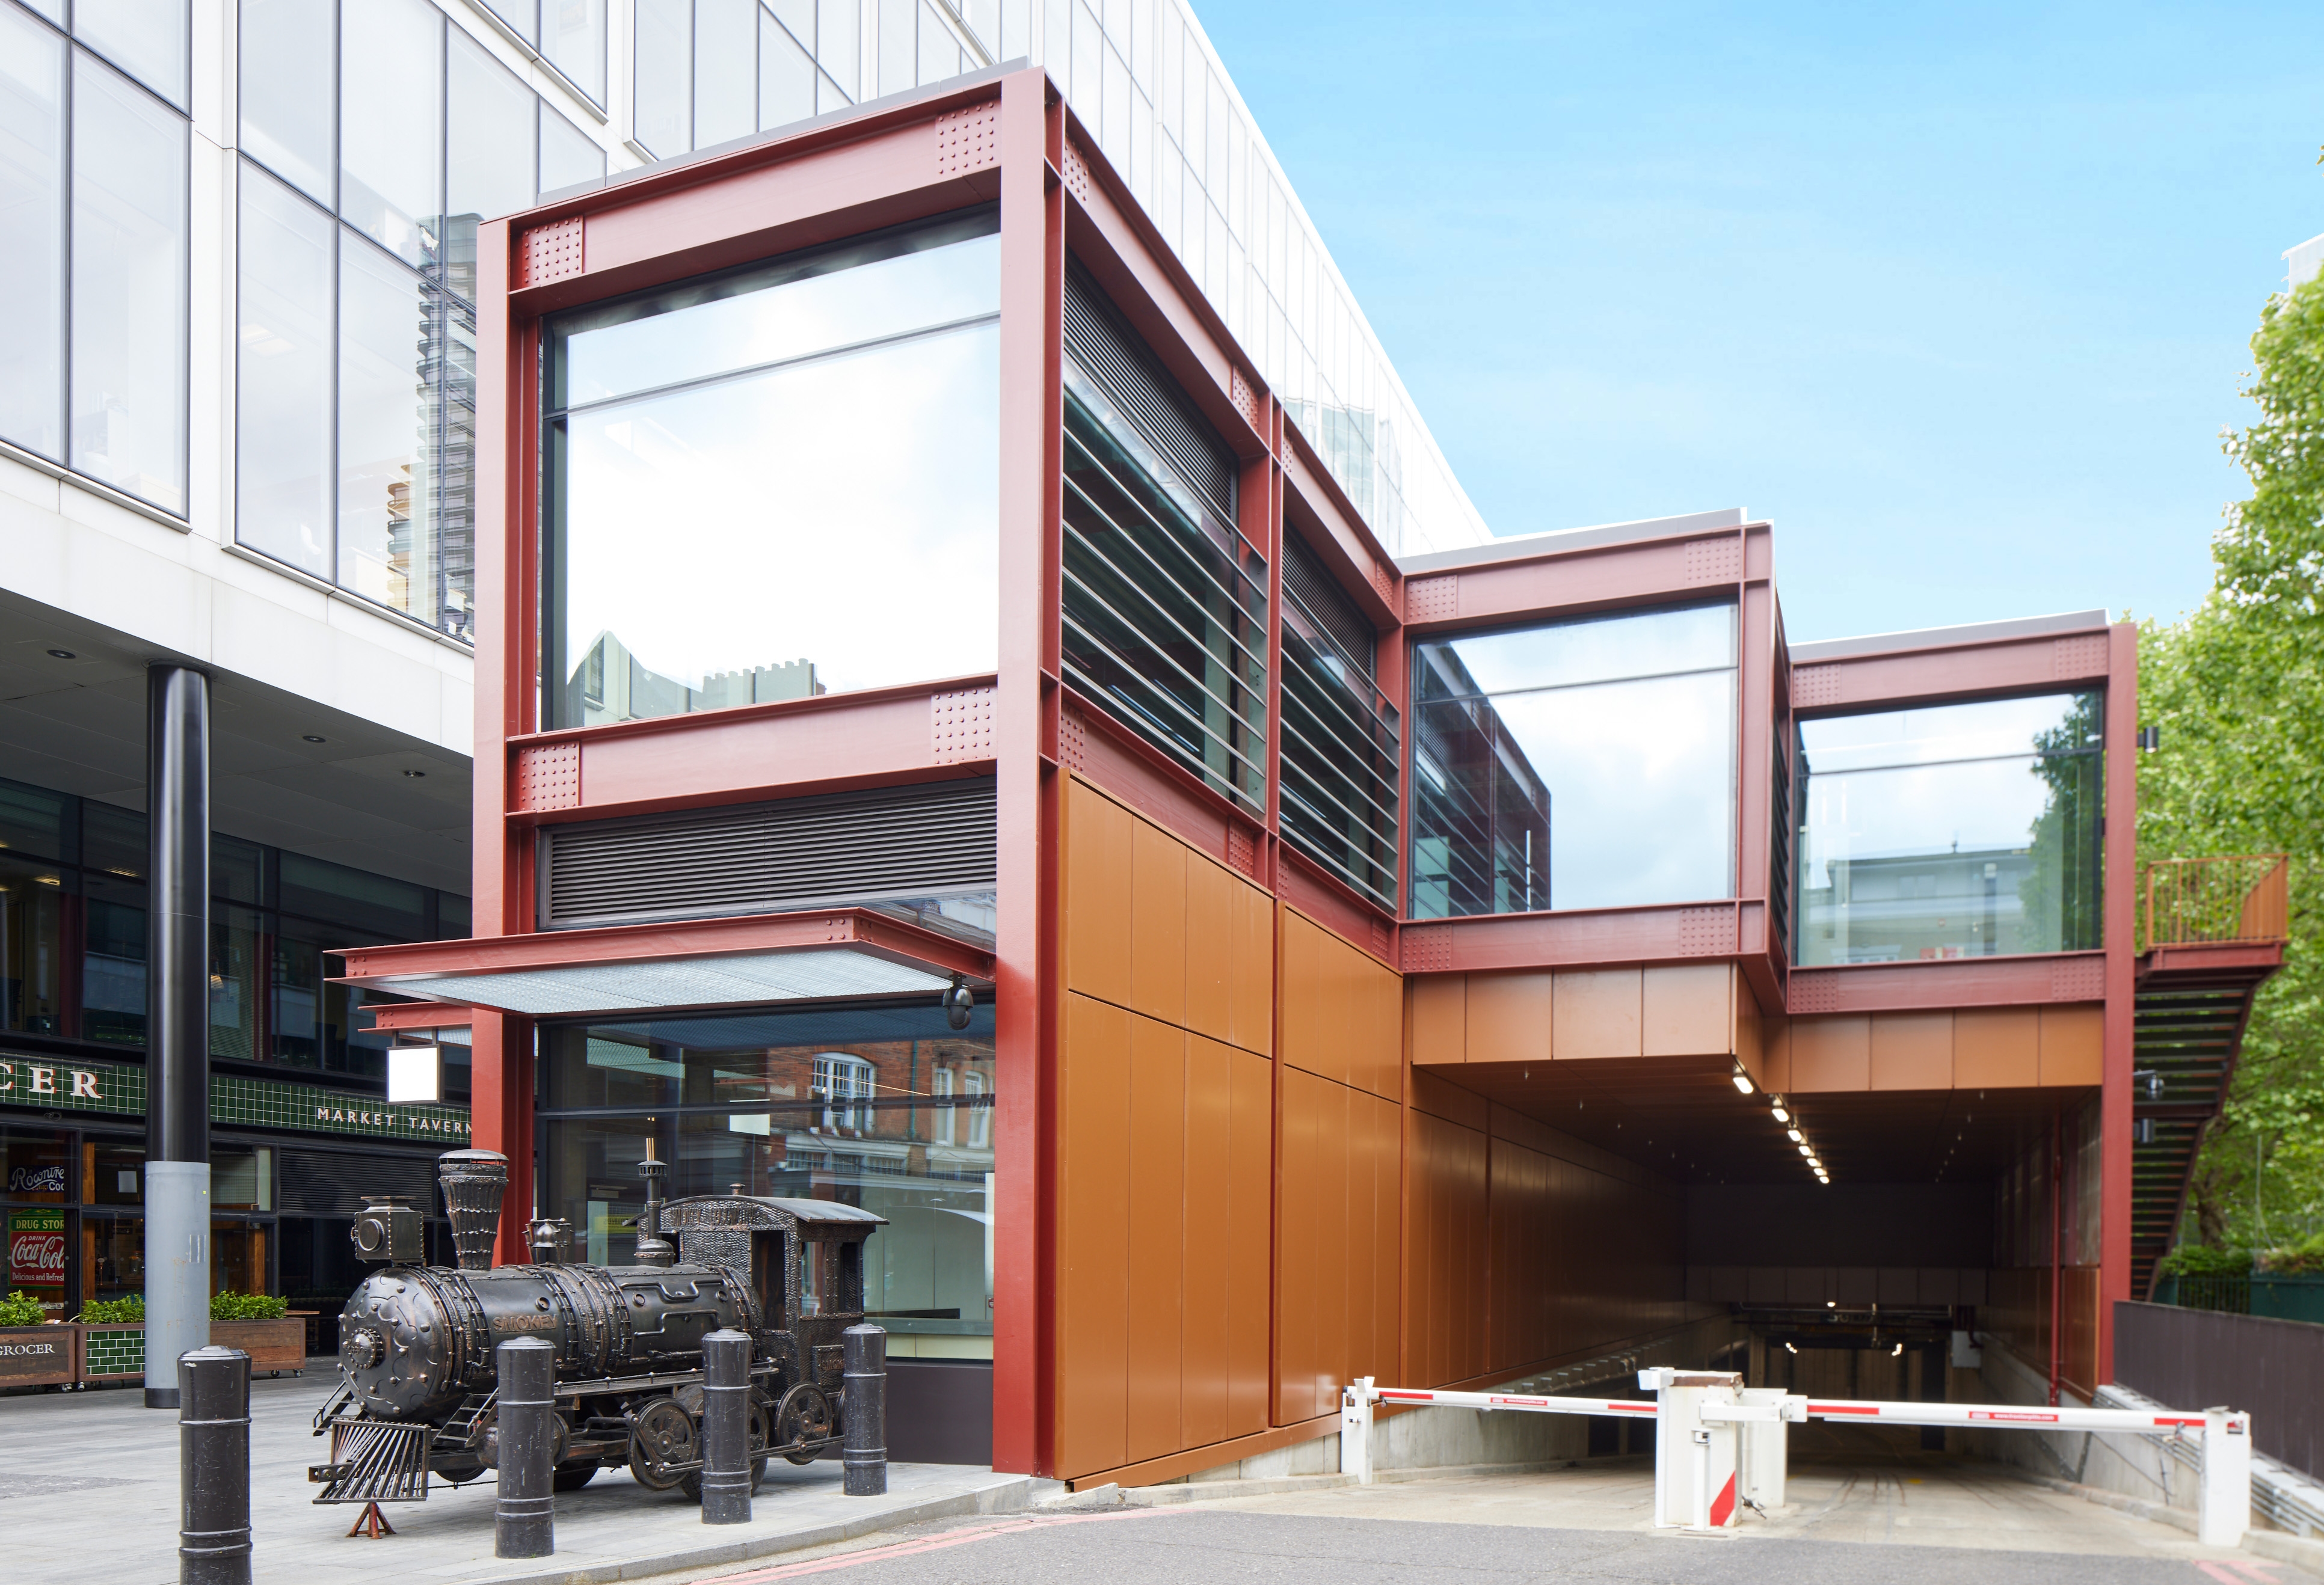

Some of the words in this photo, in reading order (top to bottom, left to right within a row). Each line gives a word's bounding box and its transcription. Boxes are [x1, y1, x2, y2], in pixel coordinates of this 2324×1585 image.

[318, 1108, 394, 1126] MARKET
[16, 1220, 39, 1228] DRUG
[11, 1236, 64, 1269] Coca-Col
[493, 1314, 557, 1333] SMOKEY
